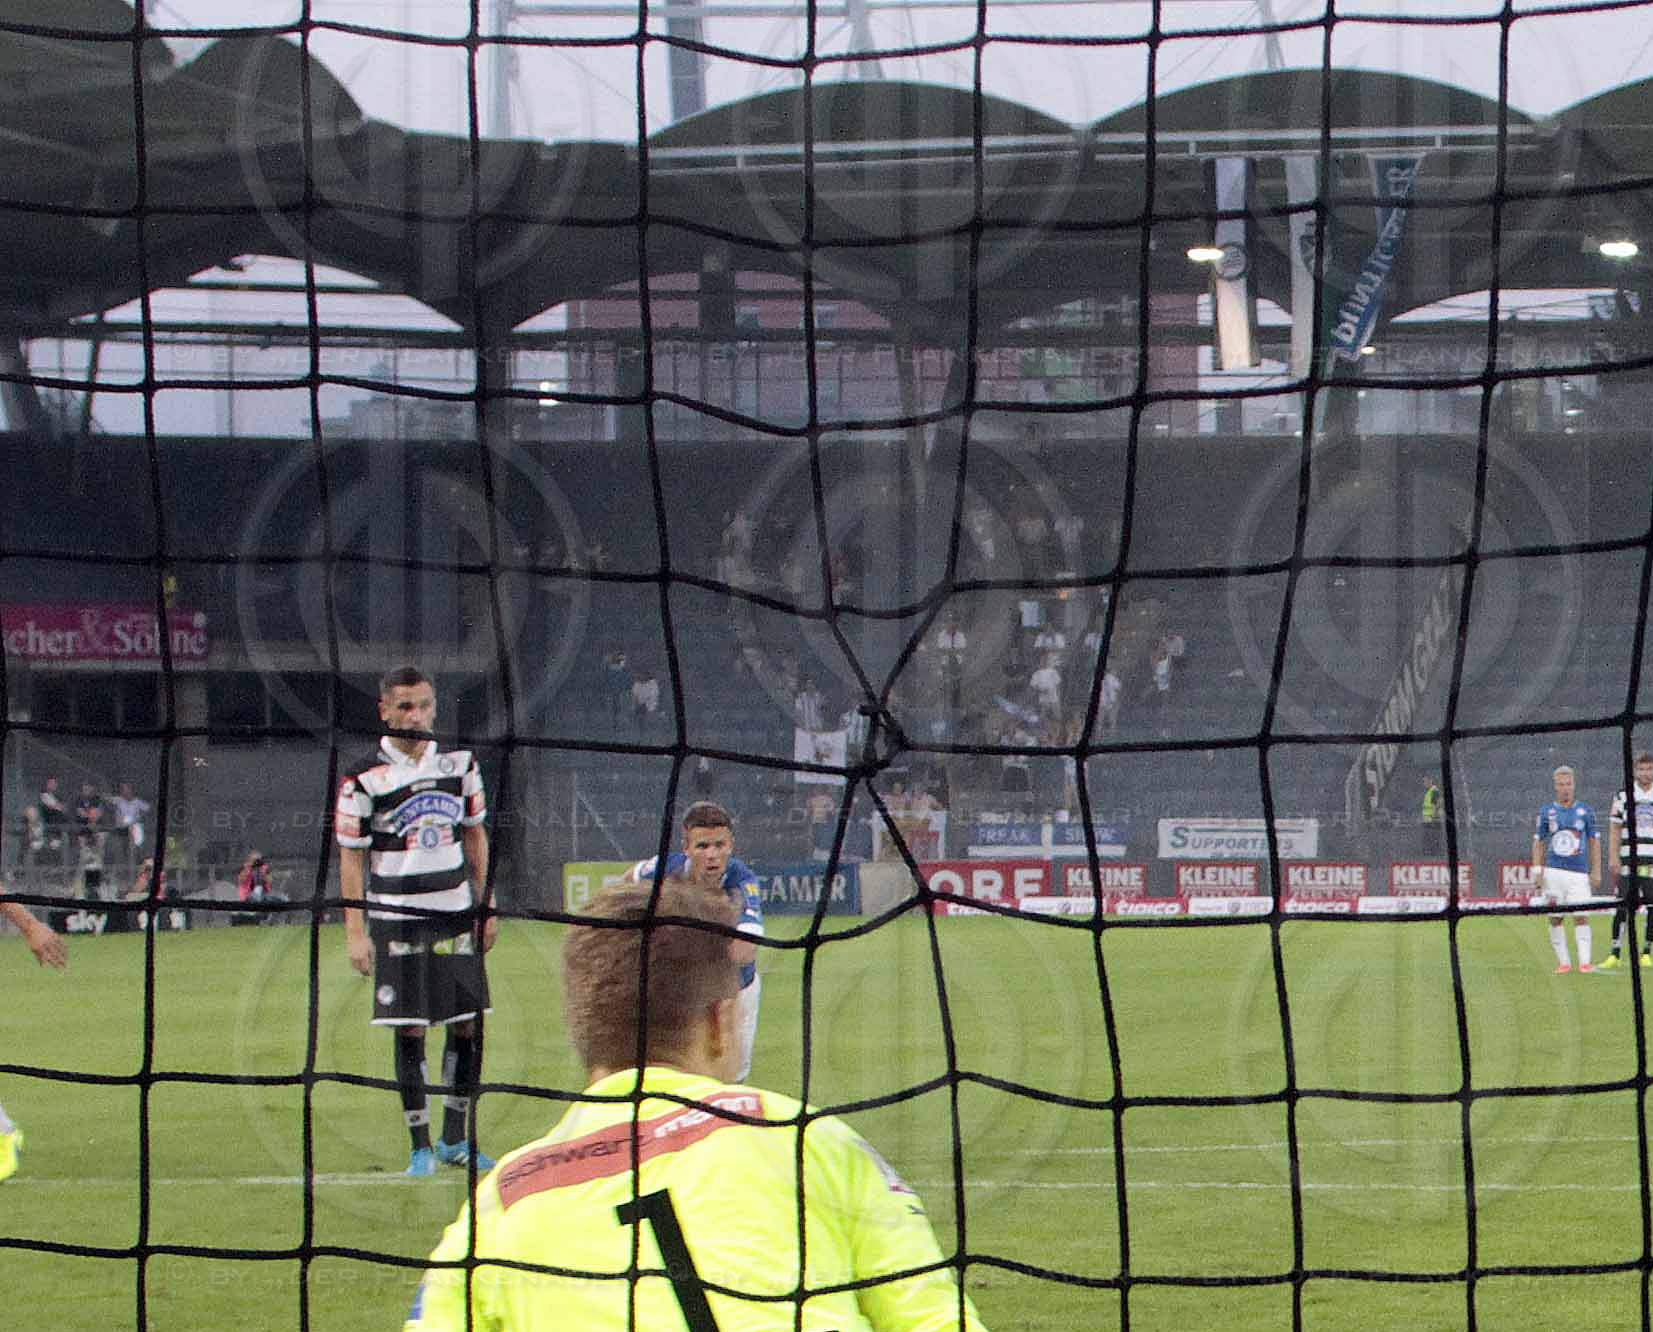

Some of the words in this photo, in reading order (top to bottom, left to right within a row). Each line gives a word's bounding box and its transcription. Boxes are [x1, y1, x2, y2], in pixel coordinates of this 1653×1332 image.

[1170, 827, 1294, 850] SUPPORTES
[1067, 867, 1143, 887] KLEINE
[1179, 865, 1256, 885] KLEINE
[1287, 865, 1365, 886] KLEINE
[1392, 865, 1470, 885] KLEINE
